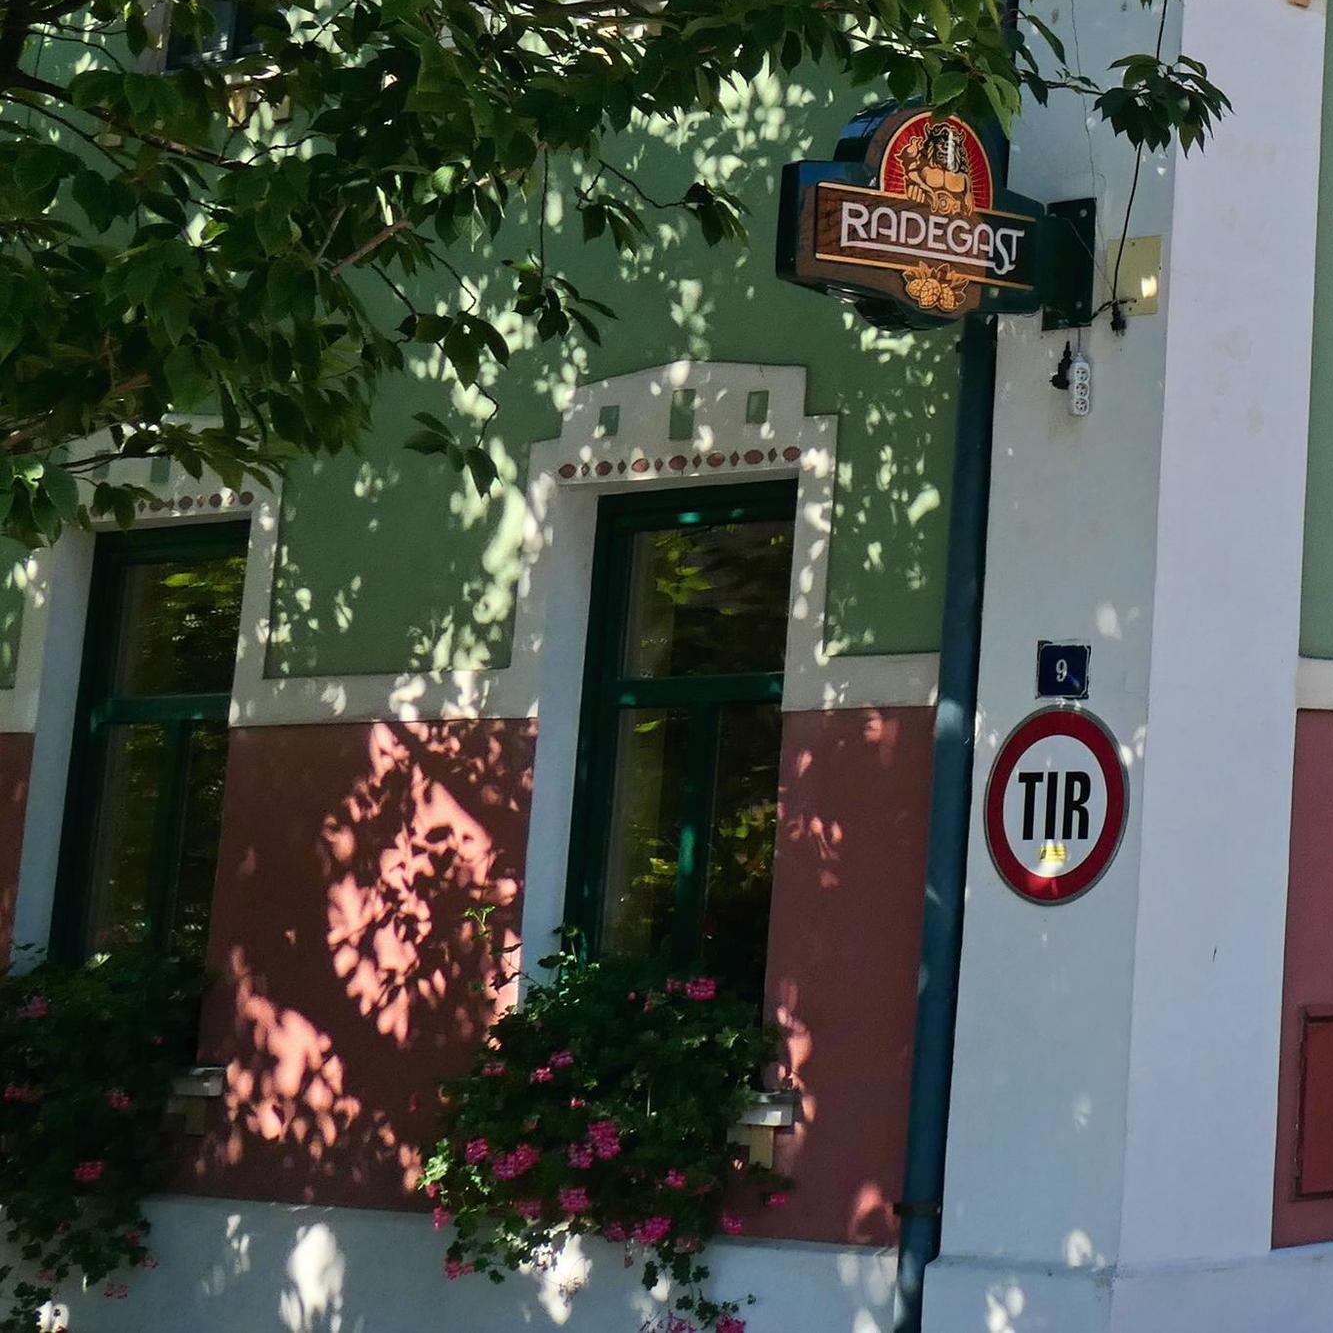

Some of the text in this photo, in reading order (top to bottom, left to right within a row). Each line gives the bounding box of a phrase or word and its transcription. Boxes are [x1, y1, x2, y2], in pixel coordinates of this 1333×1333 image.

[840, 201, 1025, 275] RADEGAST
[1055, 658, 1068, 683] 9
[1018, 771, 1091, 841] TIR
